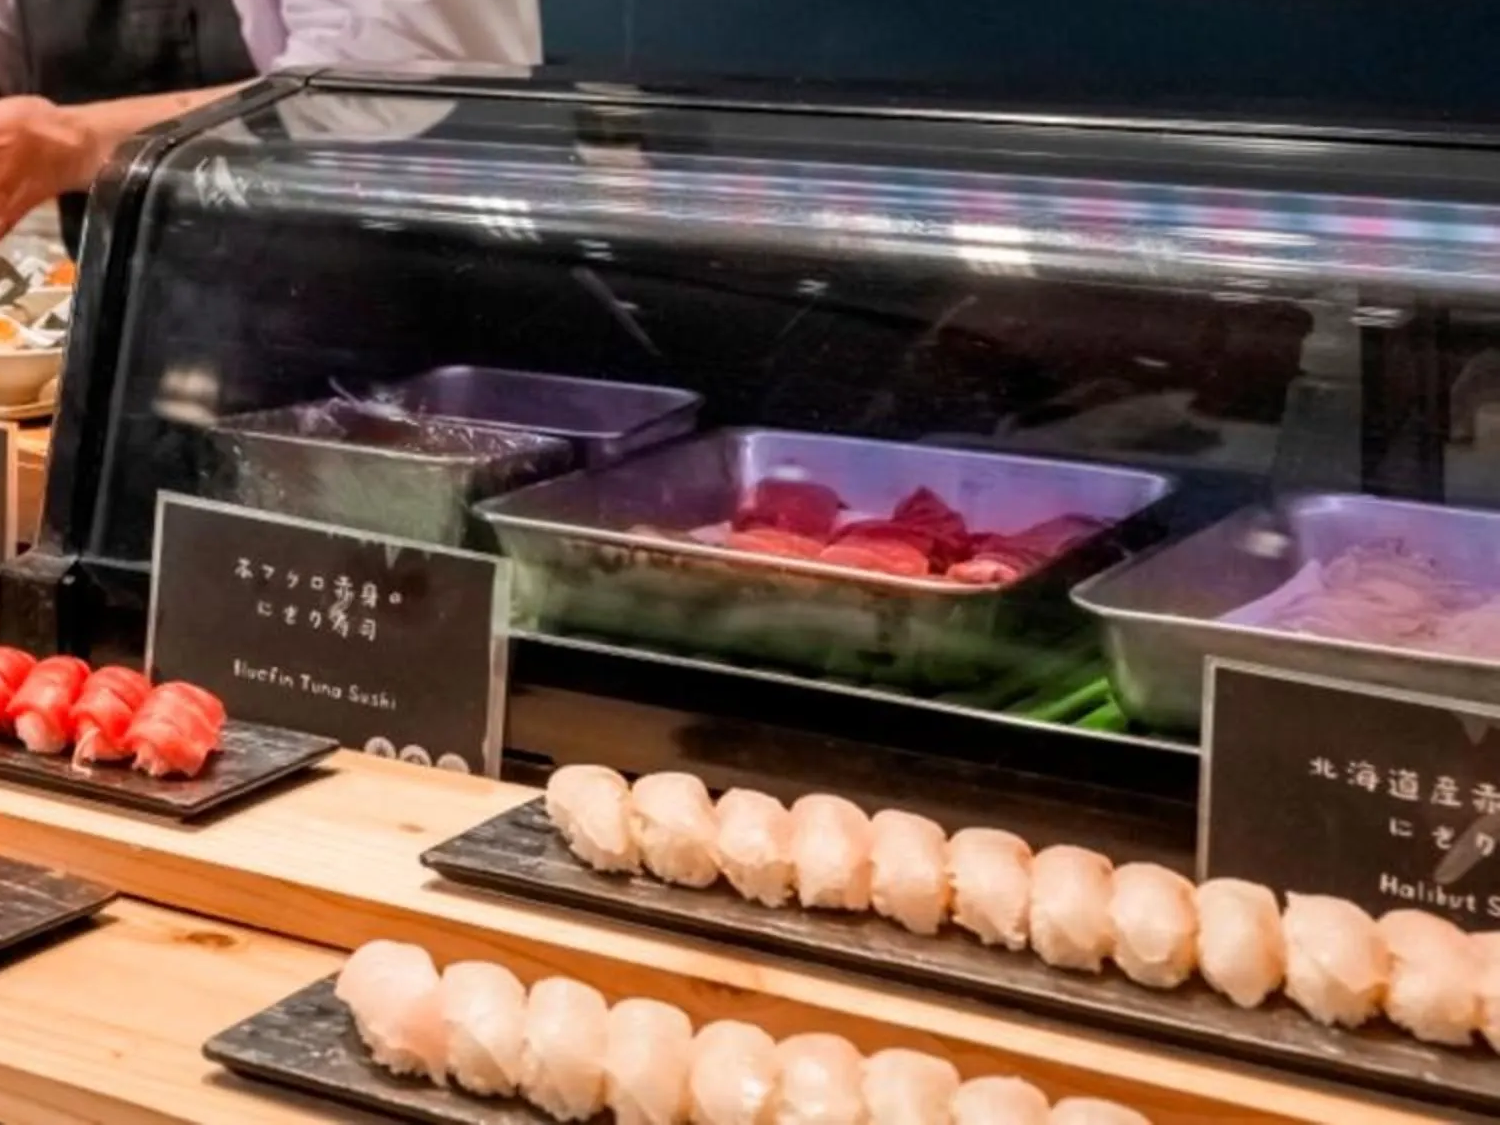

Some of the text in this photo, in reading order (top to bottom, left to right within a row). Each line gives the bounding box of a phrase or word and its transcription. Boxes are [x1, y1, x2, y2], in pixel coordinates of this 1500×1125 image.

[234, 557, 403, 609] 本マグロ赤身の
[233, 658, 397, 711] Bluefin Tuna Sushi
[1379, 871, 1477, 914] Halibut
